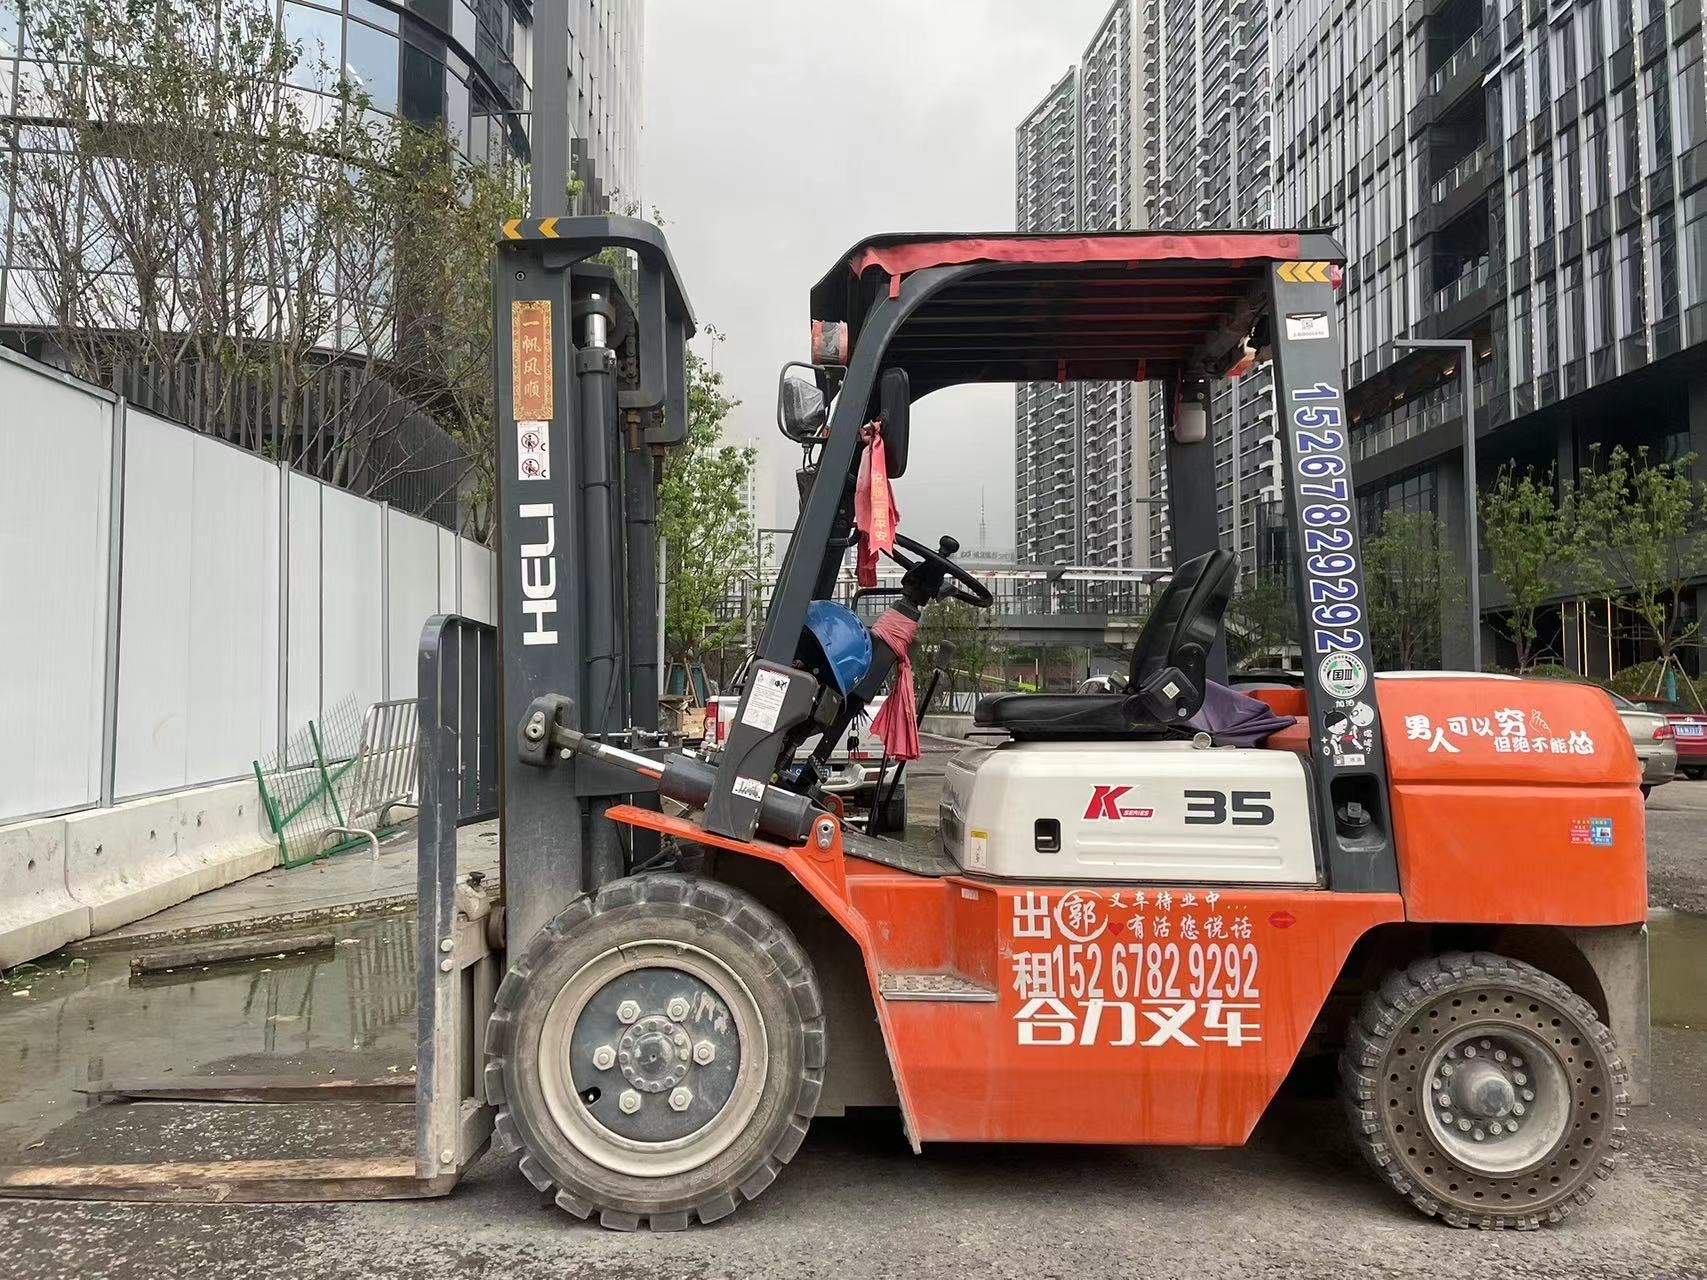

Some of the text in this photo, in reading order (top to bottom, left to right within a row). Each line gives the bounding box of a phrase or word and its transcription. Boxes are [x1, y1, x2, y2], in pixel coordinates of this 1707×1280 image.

[522, 320, 543, 399] 一帆风顺
[1292, 382, 1363, 653] 15267829292
[519, 503, 558, 645] HELI
[1404, 707, 1527, 753] 男人可以穷
[1493, 730, 1595, 755] 但绝不能怂
[1082, 785, 1135, 820] K
[1122, 809, 1151, 817] SERIES
[1183, 789, 1275, 826] 35
[1065, 896, 1096, 935] 郭
[1127, 914, 1253, 940] 有活您说话
[1053, 942, 1259, 999] 152 6782 9292
[1013, 998, 1263, 1048] 合力叉车
